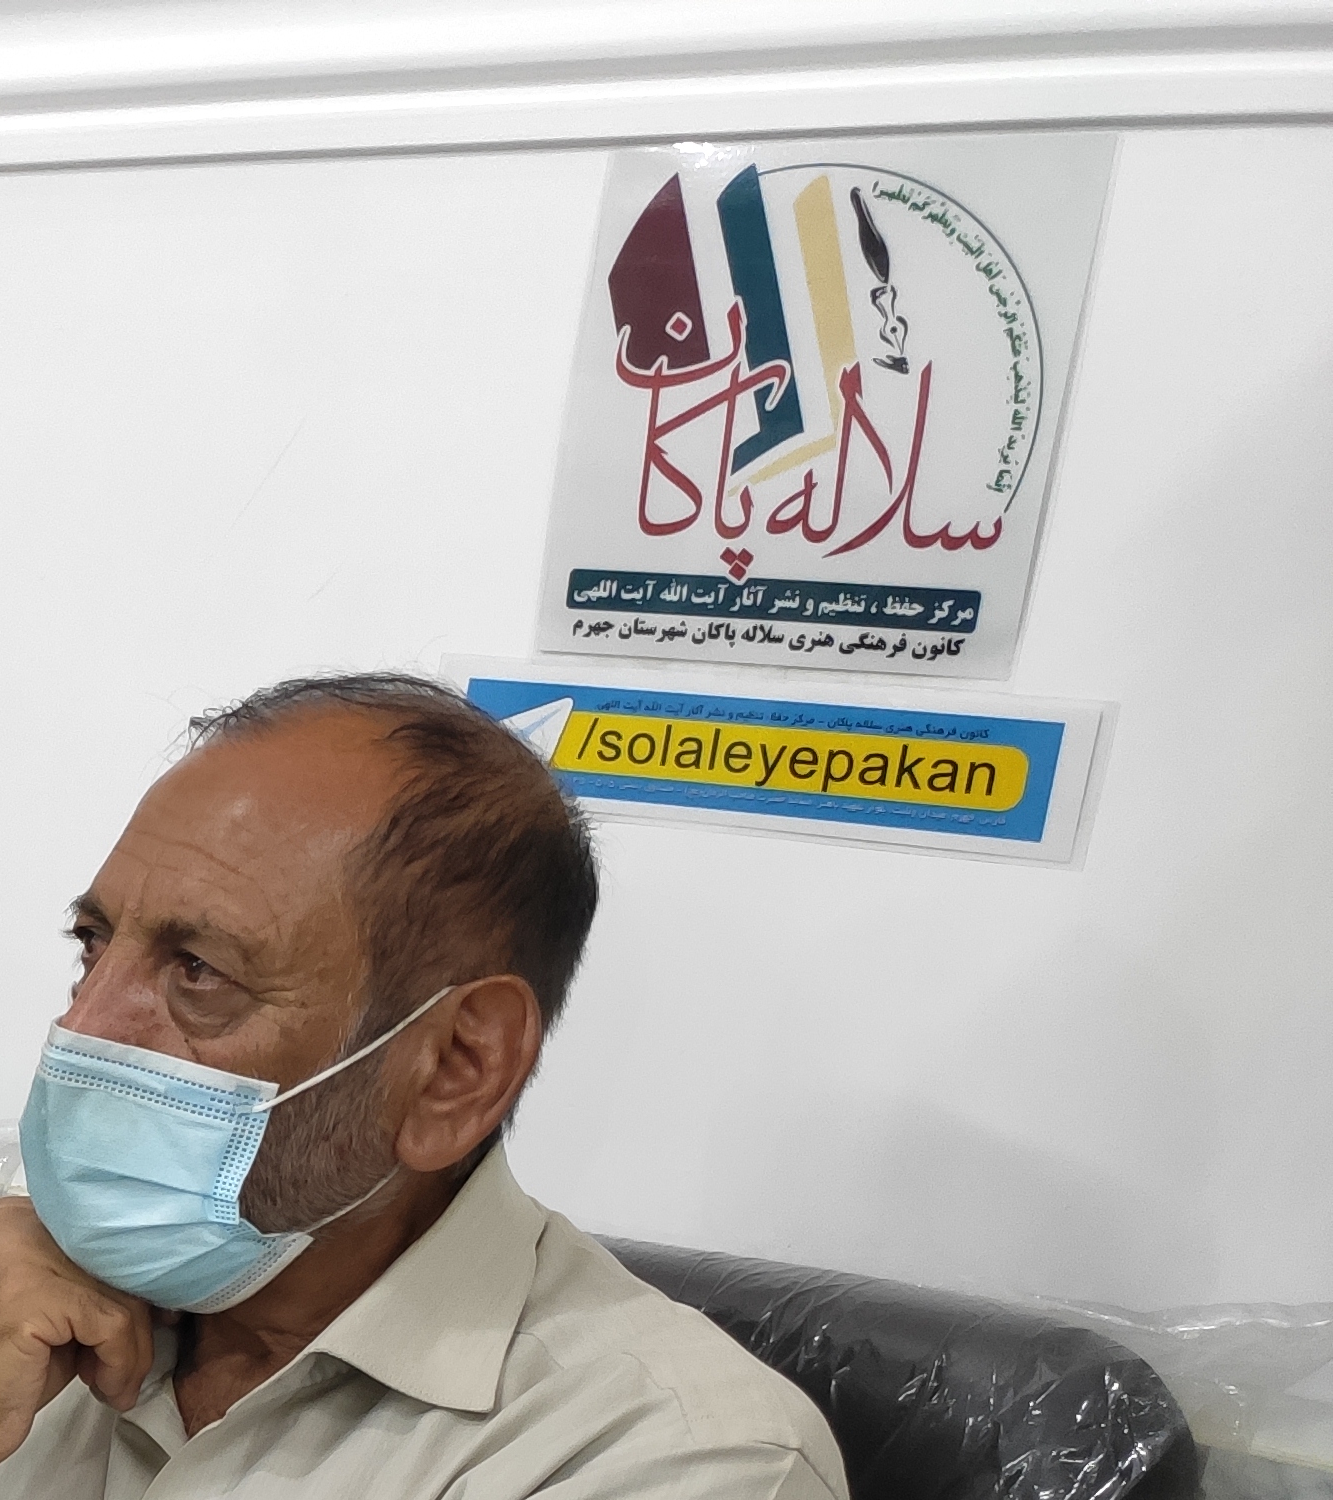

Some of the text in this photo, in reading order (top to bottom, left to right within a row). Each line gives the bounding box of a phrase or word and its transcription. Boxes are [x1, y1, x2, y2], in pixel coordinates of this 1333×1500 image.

[573, 579, 617, 602] اللهی
[621, 580, 657, 604] آیت
[659, 578, 688, 602] الله
[691, 583, 729, 609] آیت
[729, 585, 767, 612] آثار
[767, 590, 800, 613] نشر
[802, 600, 813, 616] و
[818, 592, 867, 617] تنظیم
[882, 595, 925, 616] حفظ
[927, 600, 974, 625] مرکز
[572, 617, 965, 661] کانون فرهنگی هنری سلاله پاکان شهرستان جهرم
